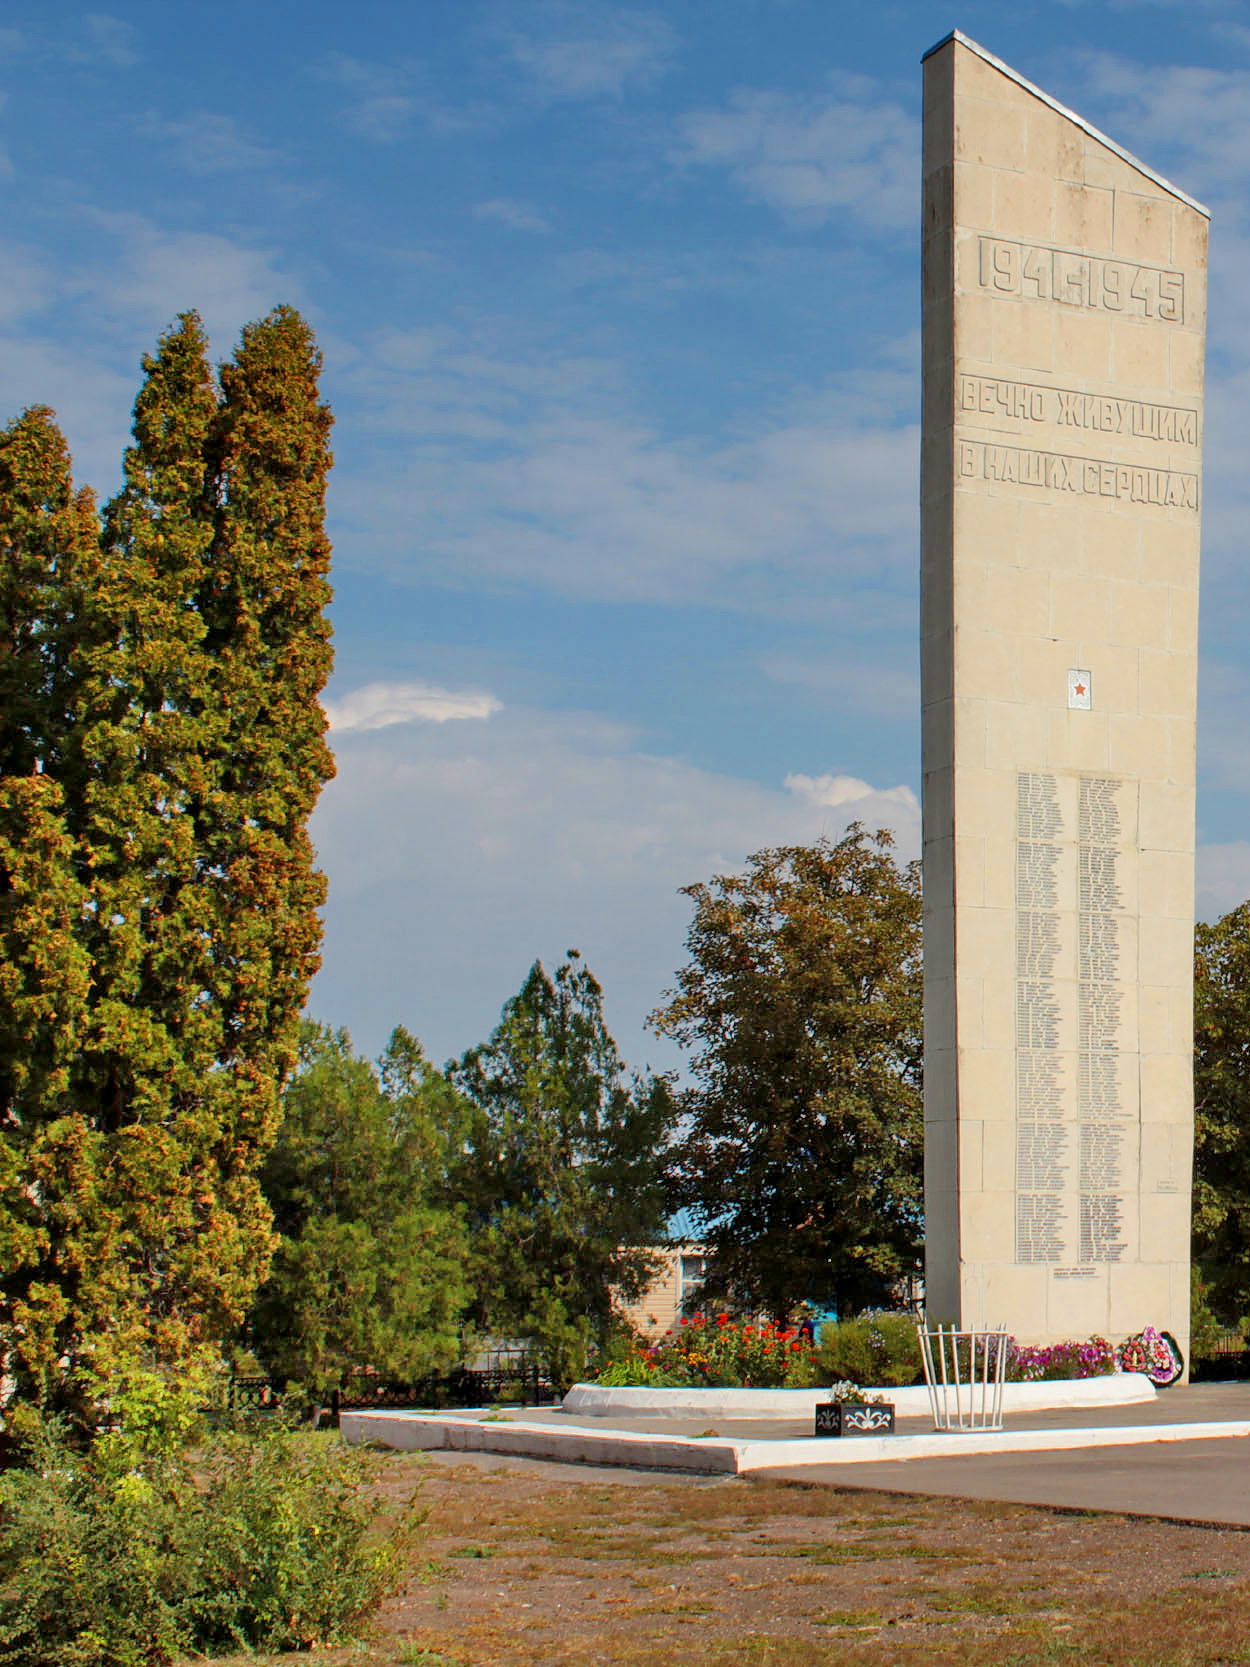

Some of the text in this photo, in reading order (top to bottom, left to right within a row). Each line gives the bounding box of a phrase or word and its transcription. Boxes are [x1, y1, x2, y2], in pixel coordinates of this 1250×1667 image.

[961, 377, 1196, 445] ВЕЧНО ЖИВУЩИМ
[961, 443, 1197, 510] В НАШИХ СЕРДЦАХ
